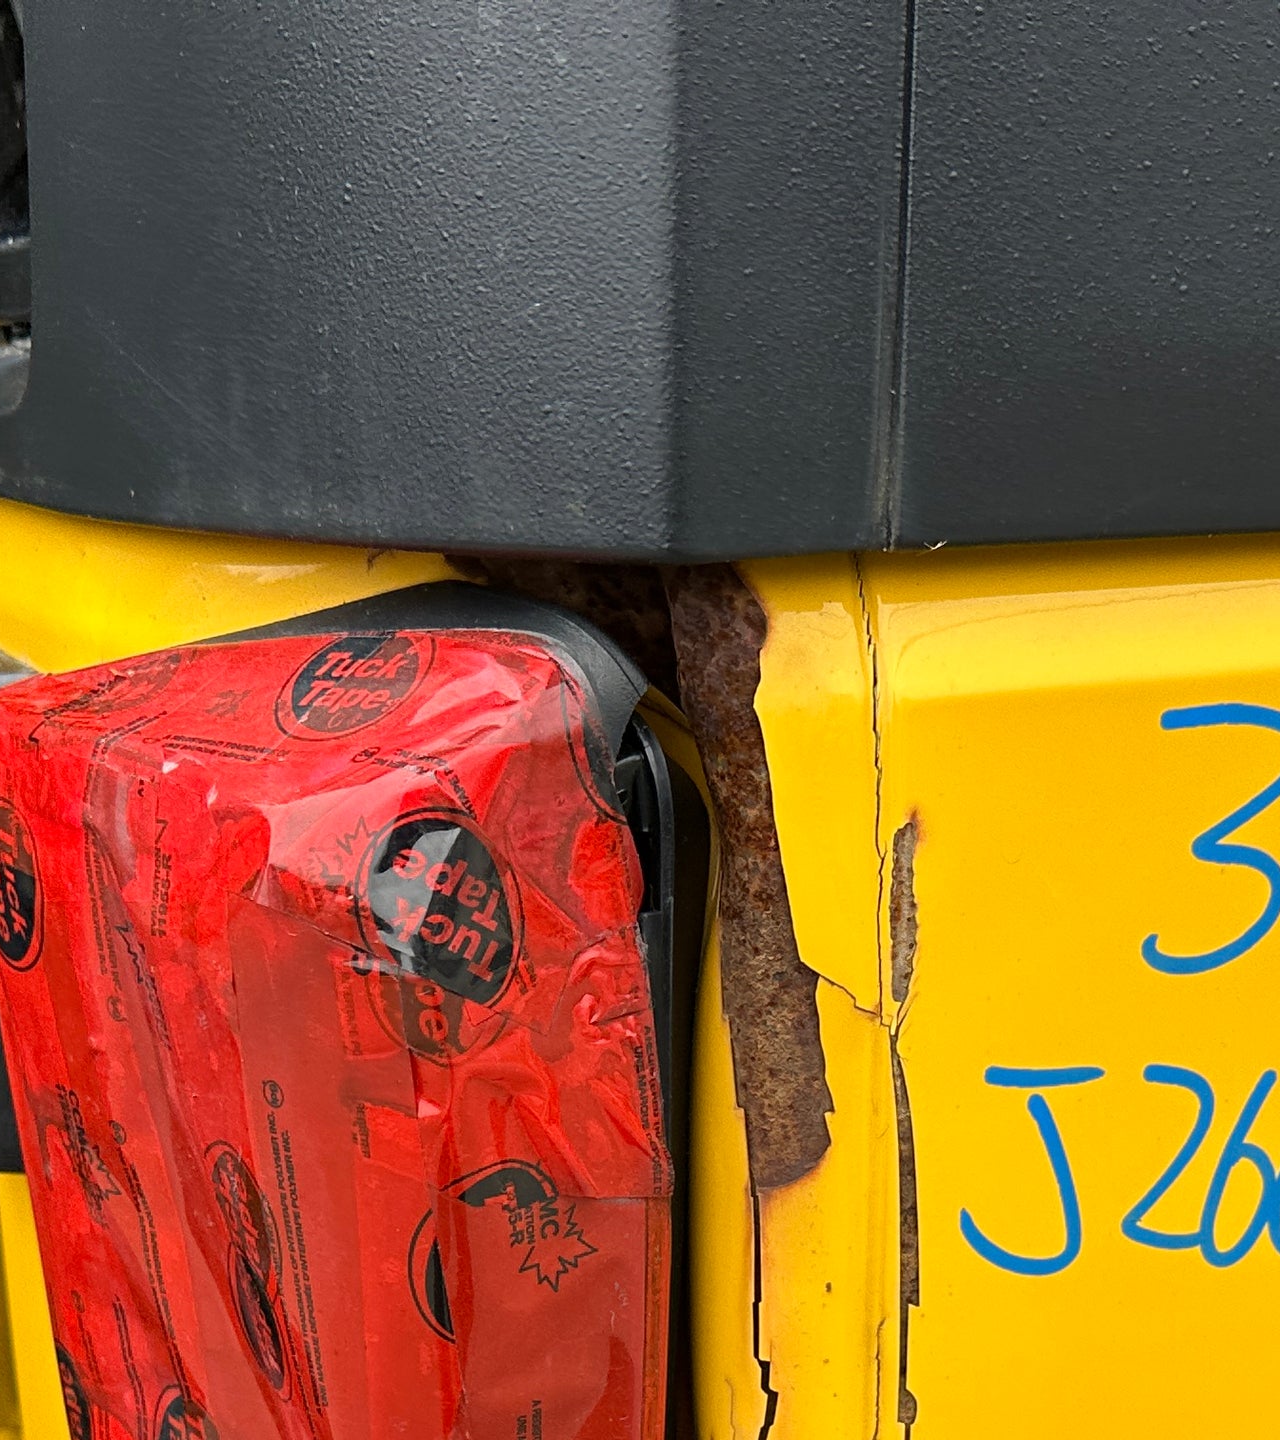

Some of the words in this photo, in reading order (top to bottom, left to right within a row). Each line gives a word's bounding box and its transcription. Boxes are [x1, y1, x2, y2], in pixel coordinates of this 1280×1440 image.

[314, 652, 409, 679] Tuck
[297, 680, 392, 713] Tape
[392, 848, 501, 932] Tape
[391, 895, 500, 982] Tuck
